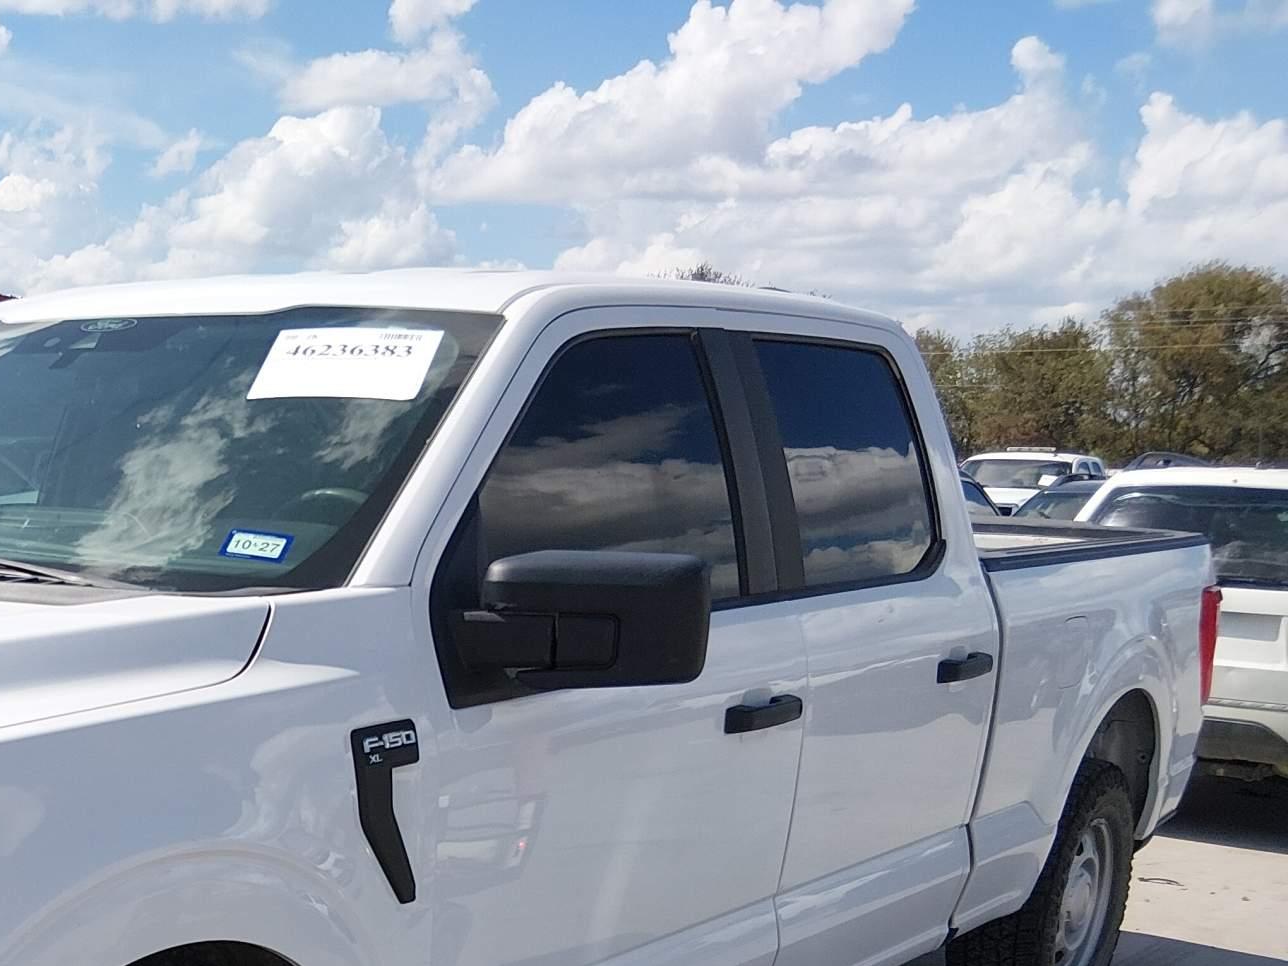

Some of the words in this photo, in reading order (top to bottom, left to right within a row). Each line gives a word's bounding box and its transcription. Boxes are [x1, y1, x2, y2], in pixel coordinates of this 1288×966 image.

[286, 343, 414, 358] 46236383
[362, 730, 417, 753] F-150
[368, 754, 384, 765] XL
